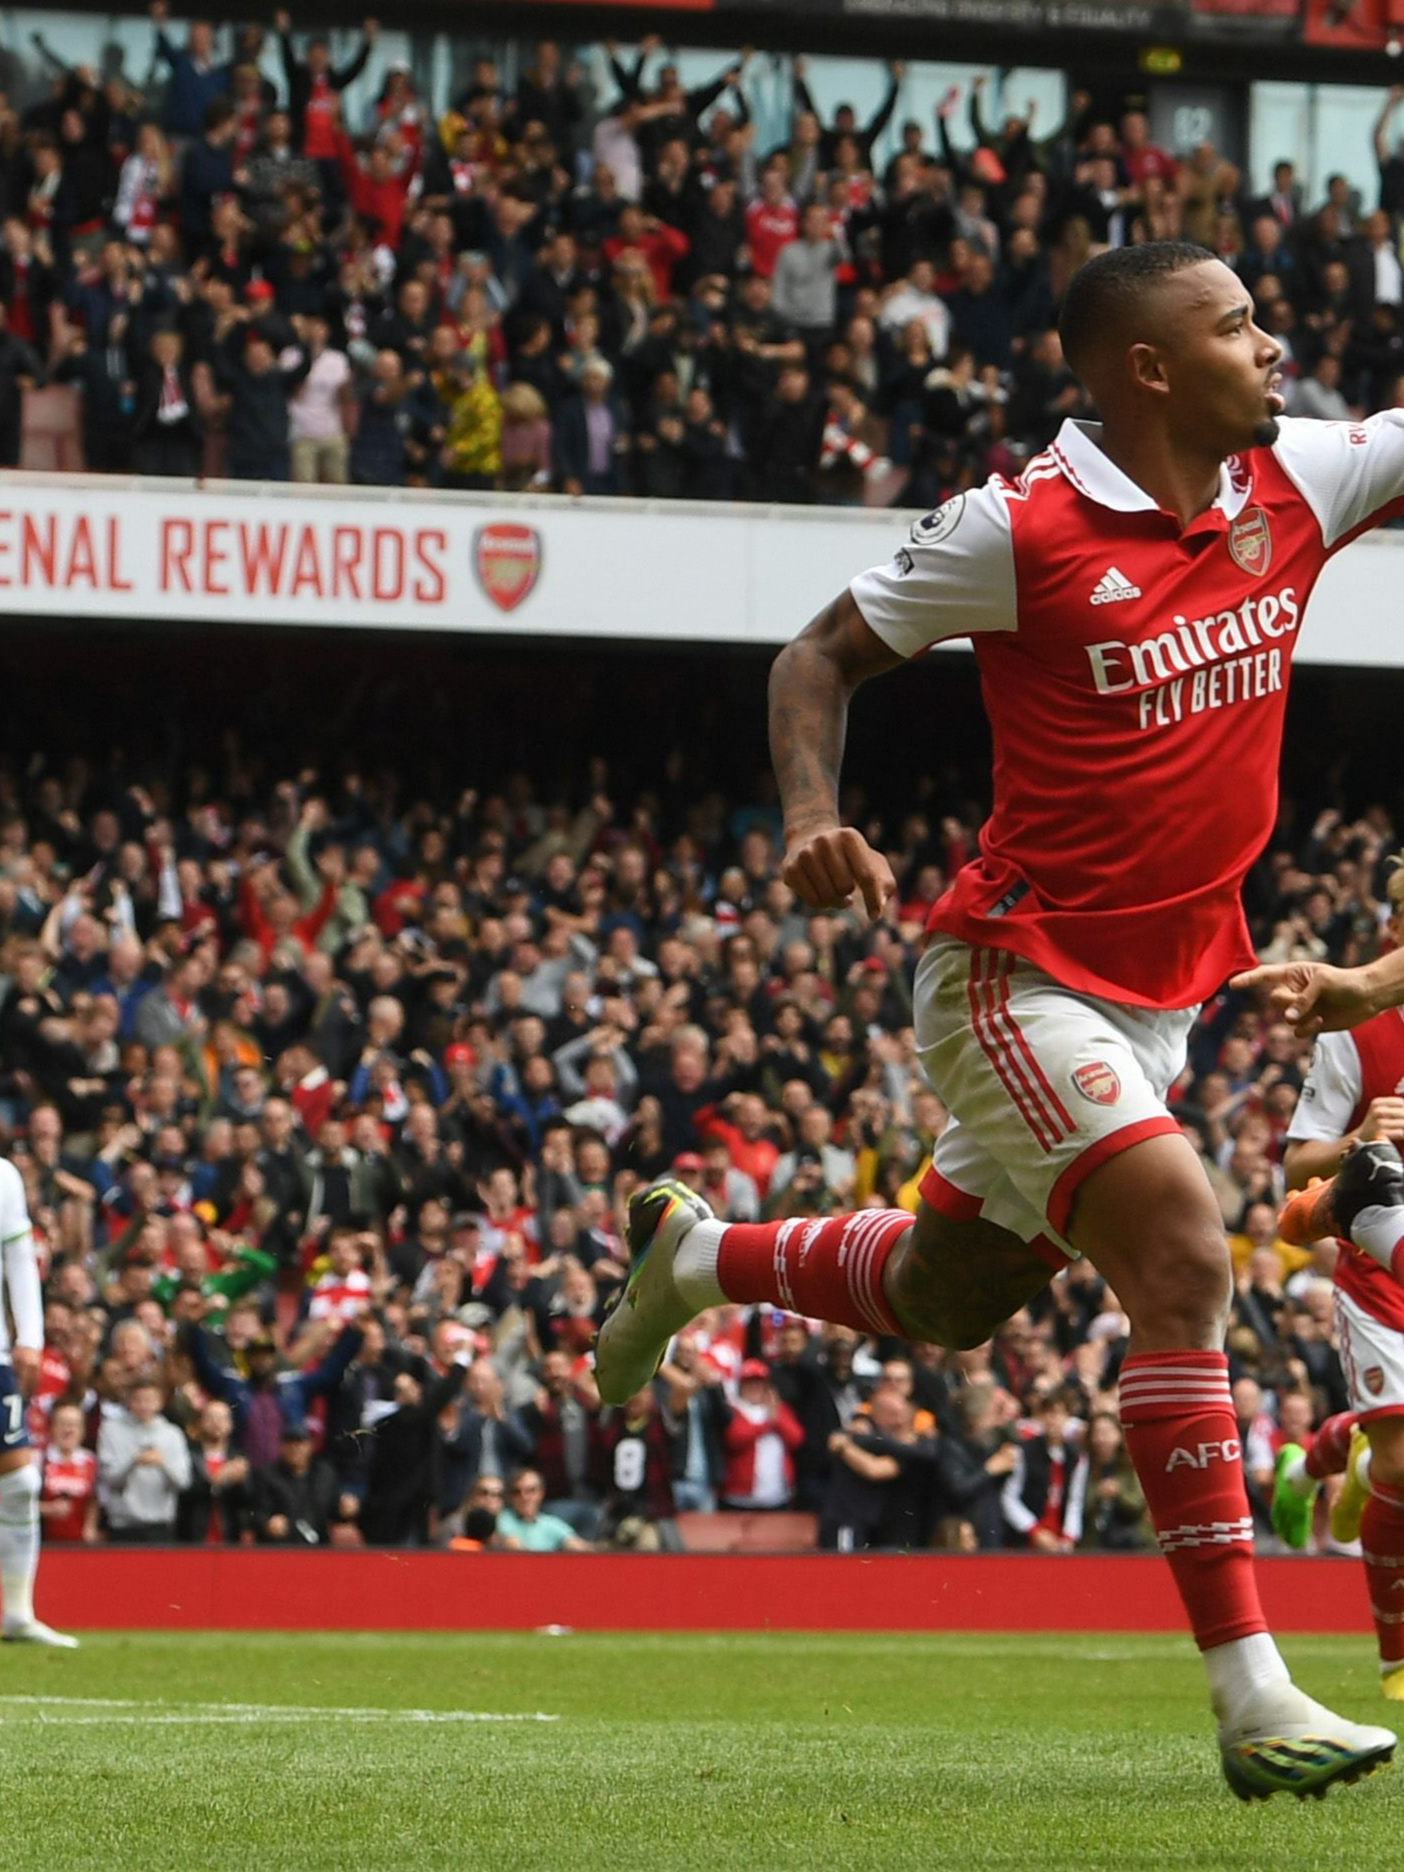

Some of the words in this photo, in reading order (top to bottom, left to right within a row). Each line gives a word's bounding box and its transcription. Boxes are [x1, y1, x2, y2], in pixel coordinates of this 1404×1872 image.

[161, 517, 446, 604] REWARDS
[1089, 586, 1142, 605] adidas
[1084, 587, 1298, 695] Emirates
[1139, 677, 1184, 729] FLY
[1191, 648, 1282, 713] BETTER
[614, 1437, 647, 1491] 8
[1165, 1439, 1240, 1473] AFC
